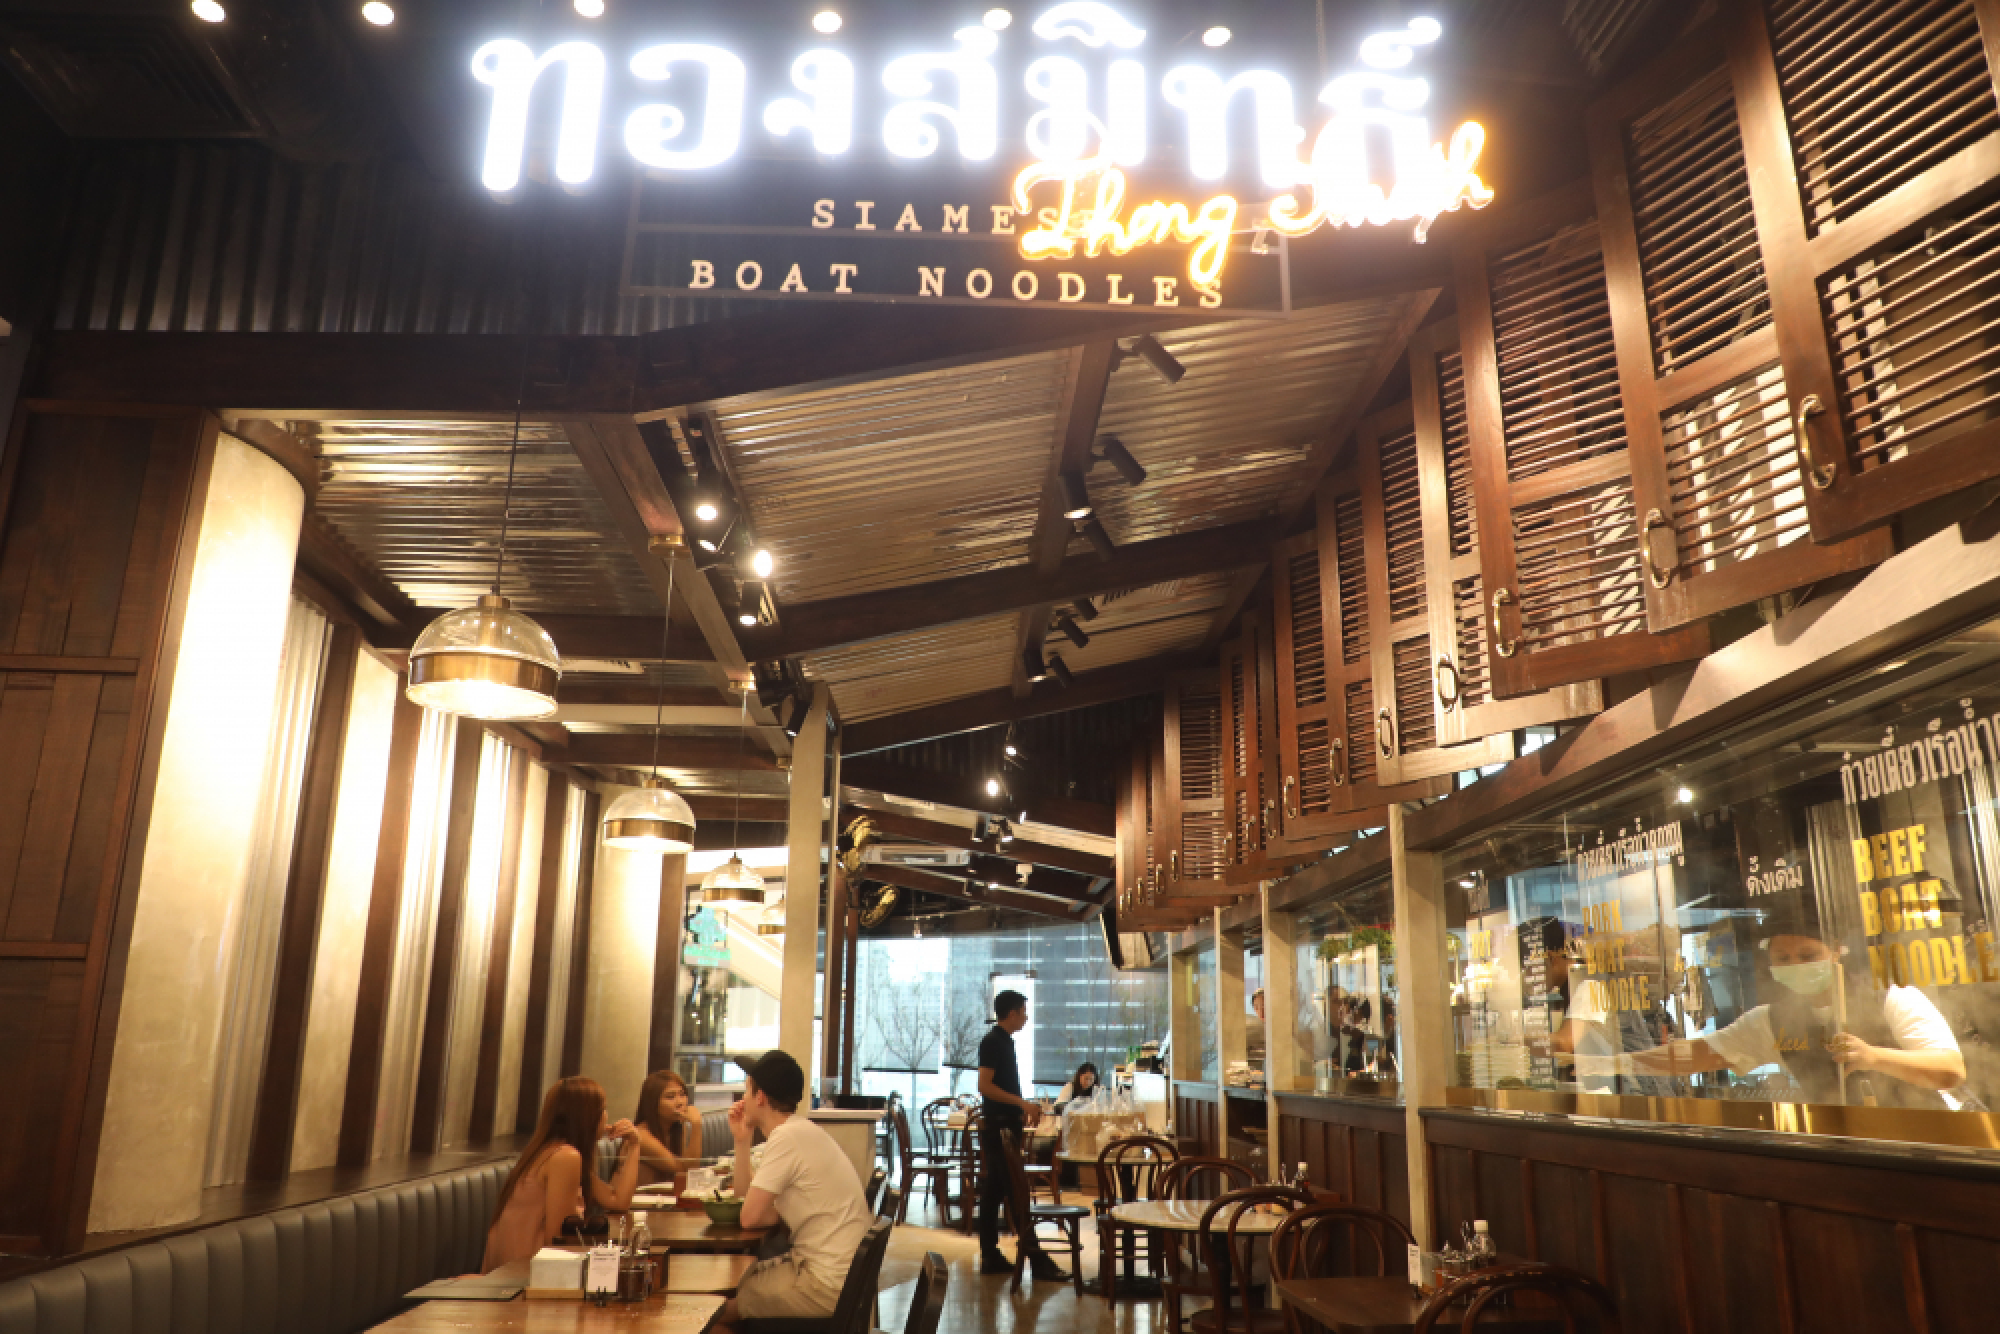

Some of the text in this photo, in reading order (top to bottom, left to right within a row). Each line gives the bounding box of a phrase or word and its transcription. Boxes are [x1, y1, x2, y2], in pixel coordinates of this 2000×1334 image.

[689, 260, 1223, 307] BOAT NOODLES
[1852, 824, 1926, 883] BEEF
[1582, 899, 1623, 937] PORK
[1860, 879, 1942, 936] BOAT
[1868, 931, 2000, 990] NOODLE
[1589, 976, 1650, 1012] NOODLE
